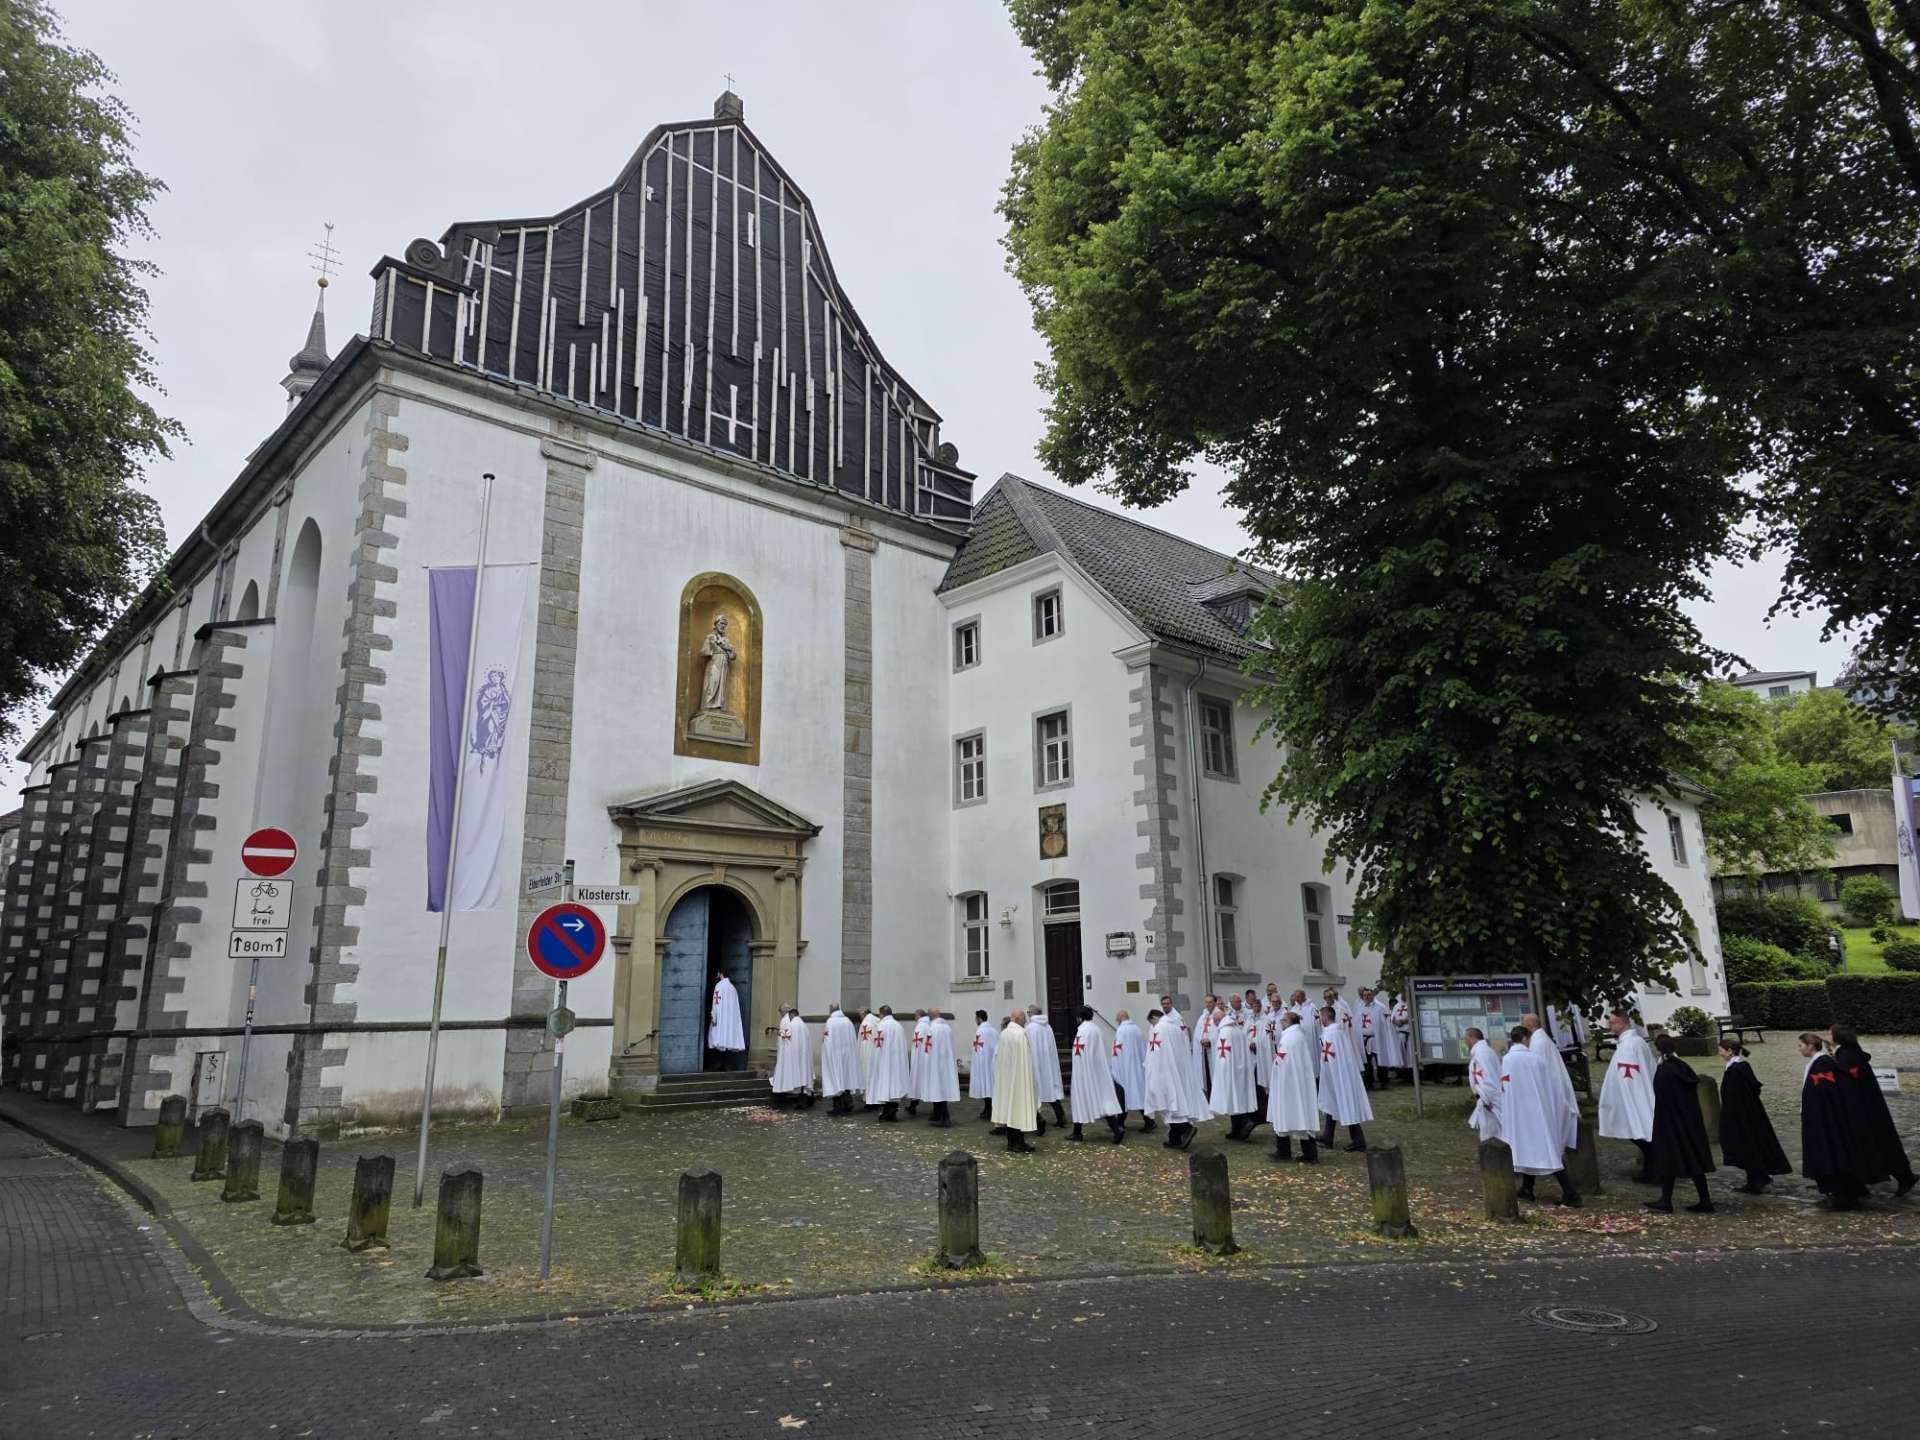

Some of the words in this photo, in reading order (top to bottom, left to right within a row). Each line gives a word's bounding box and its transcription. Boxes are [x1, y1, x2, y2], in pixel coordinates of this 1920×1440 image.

[578, 888, 631, 901] Klosterstr.
[252, 917, 271, 926] frei
[1145, 935, 1154, 944] 12
